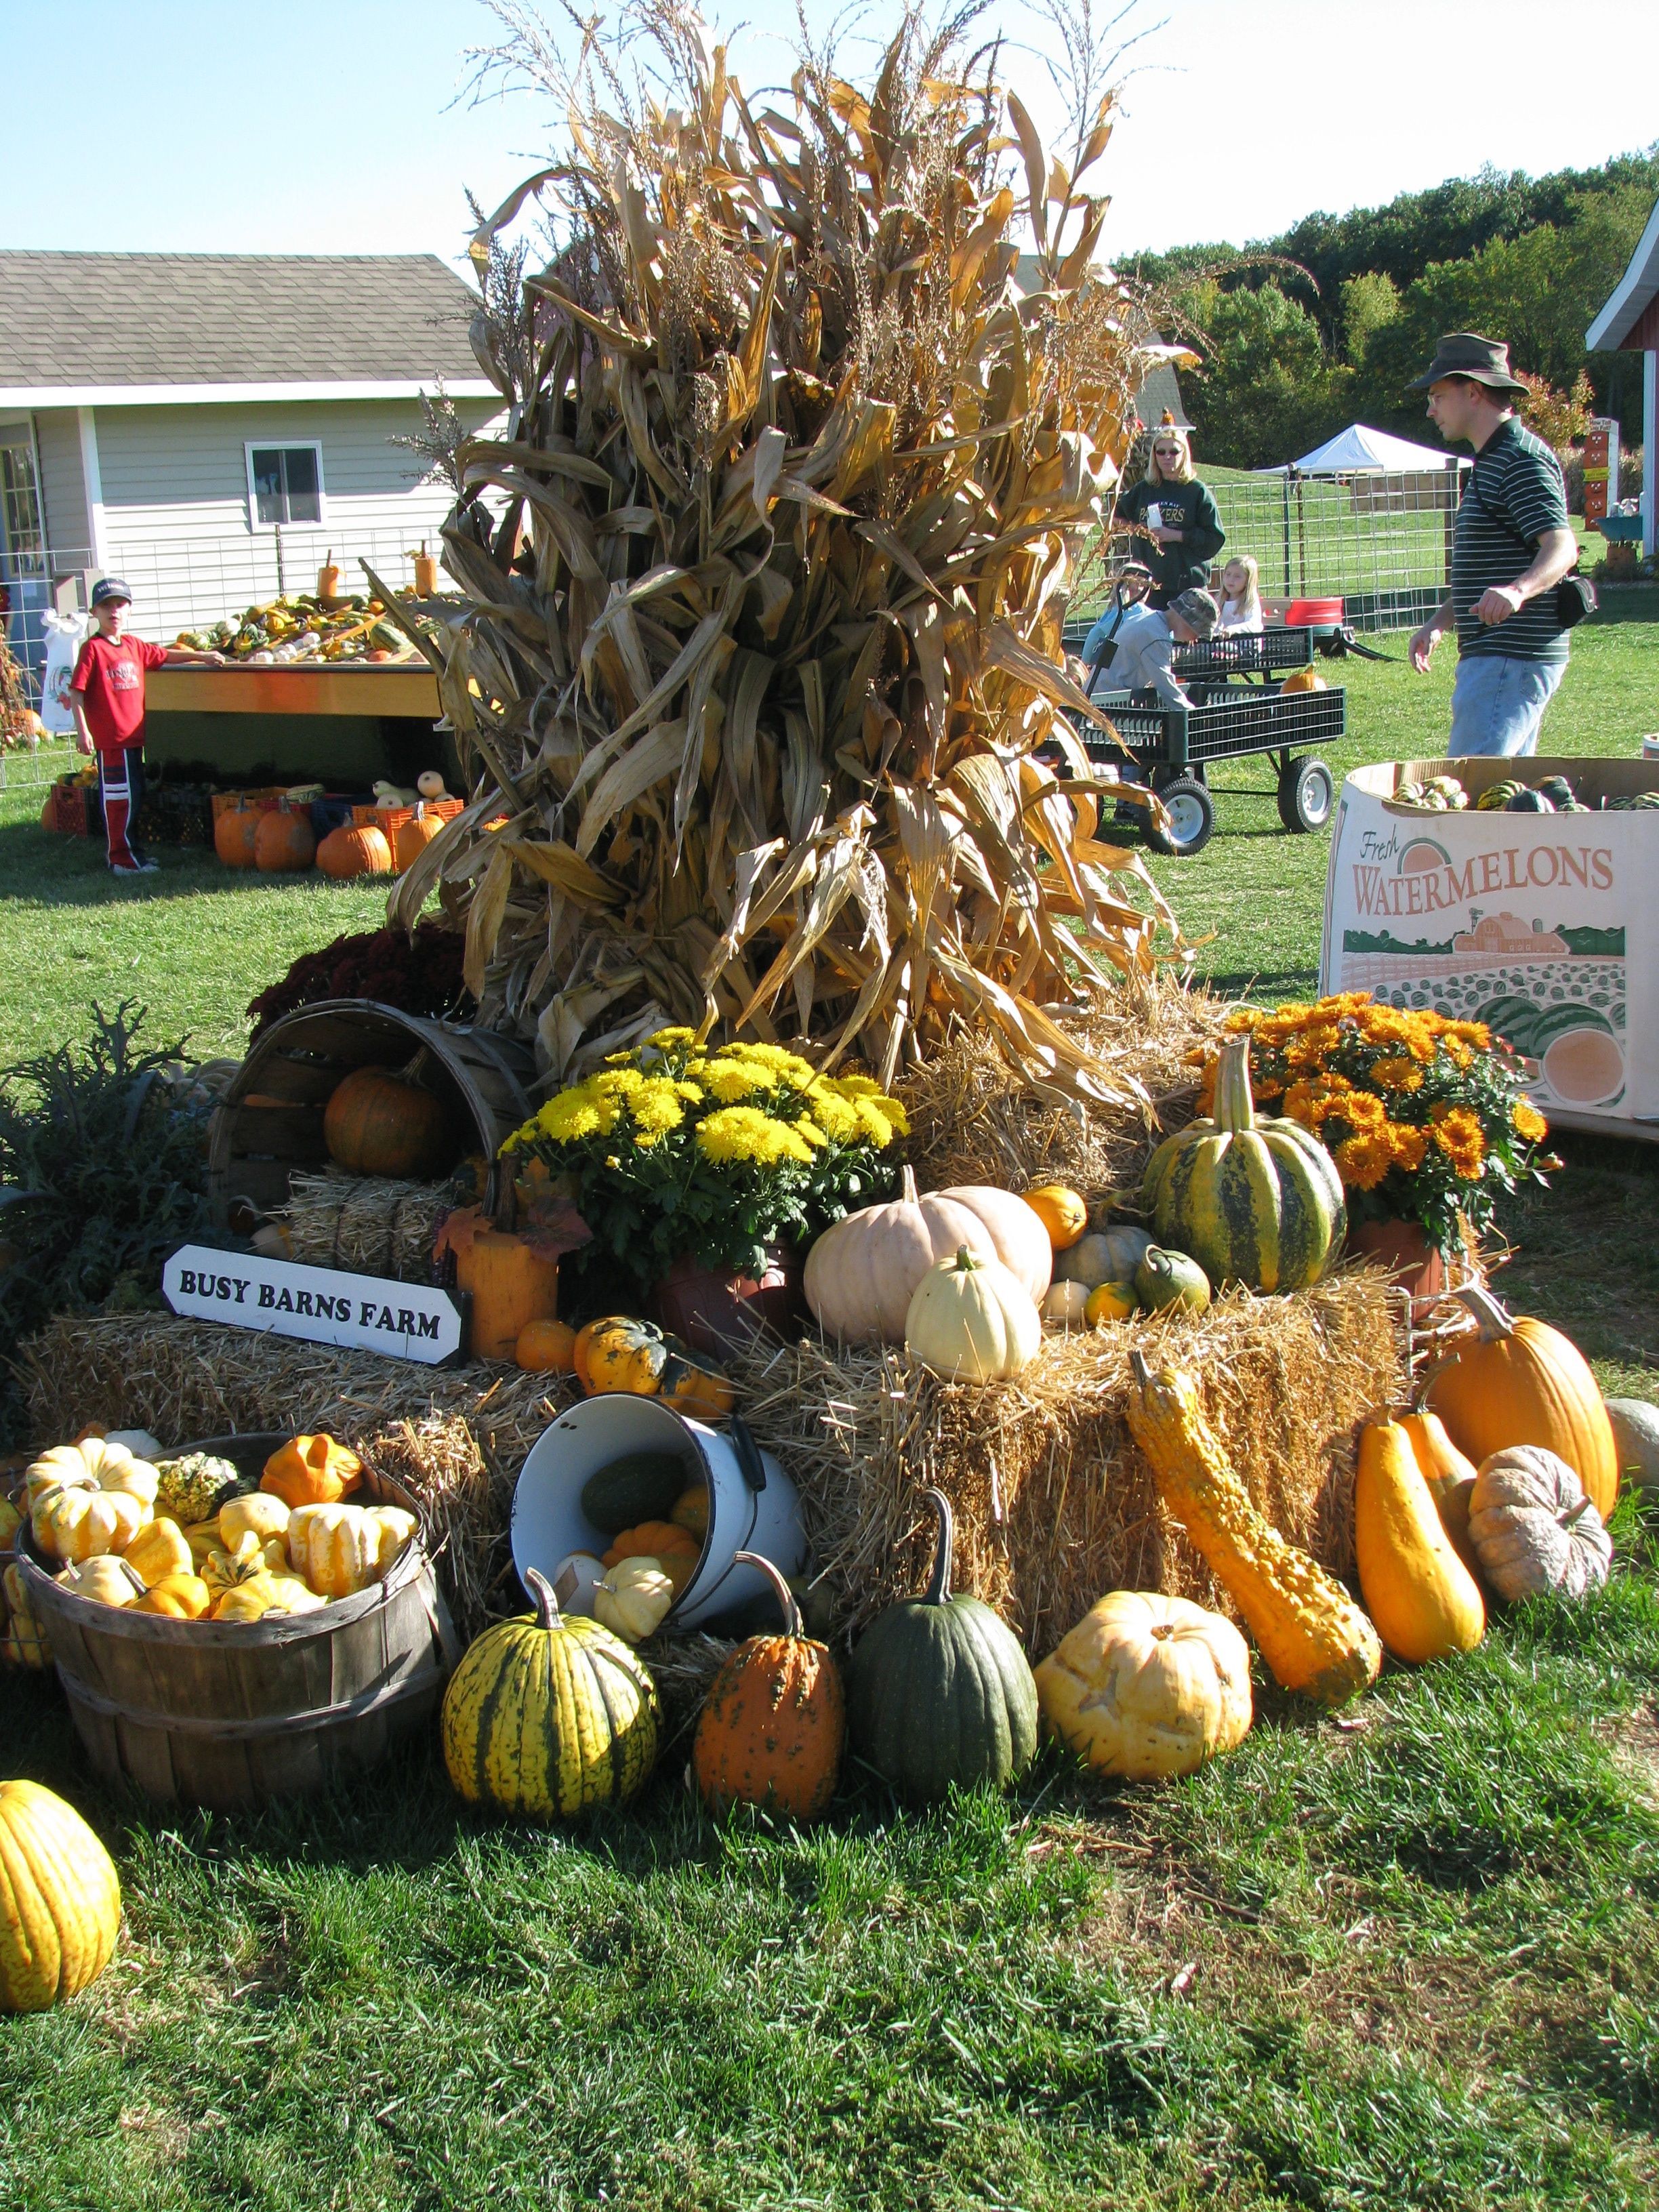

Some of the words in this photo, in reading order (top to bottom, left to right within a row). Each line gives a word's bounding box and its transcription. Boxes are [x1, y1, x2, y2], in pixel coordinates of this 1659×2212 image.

[1359, 823, 1400, 861] Fresh
[1352, 846, 1614, 916] WATERMELONS
[180, 1269, 251, 1303] BUSY
[258, 1284, 351, 1322] BARNS
[359, 1301, 441, 1340] FARM
